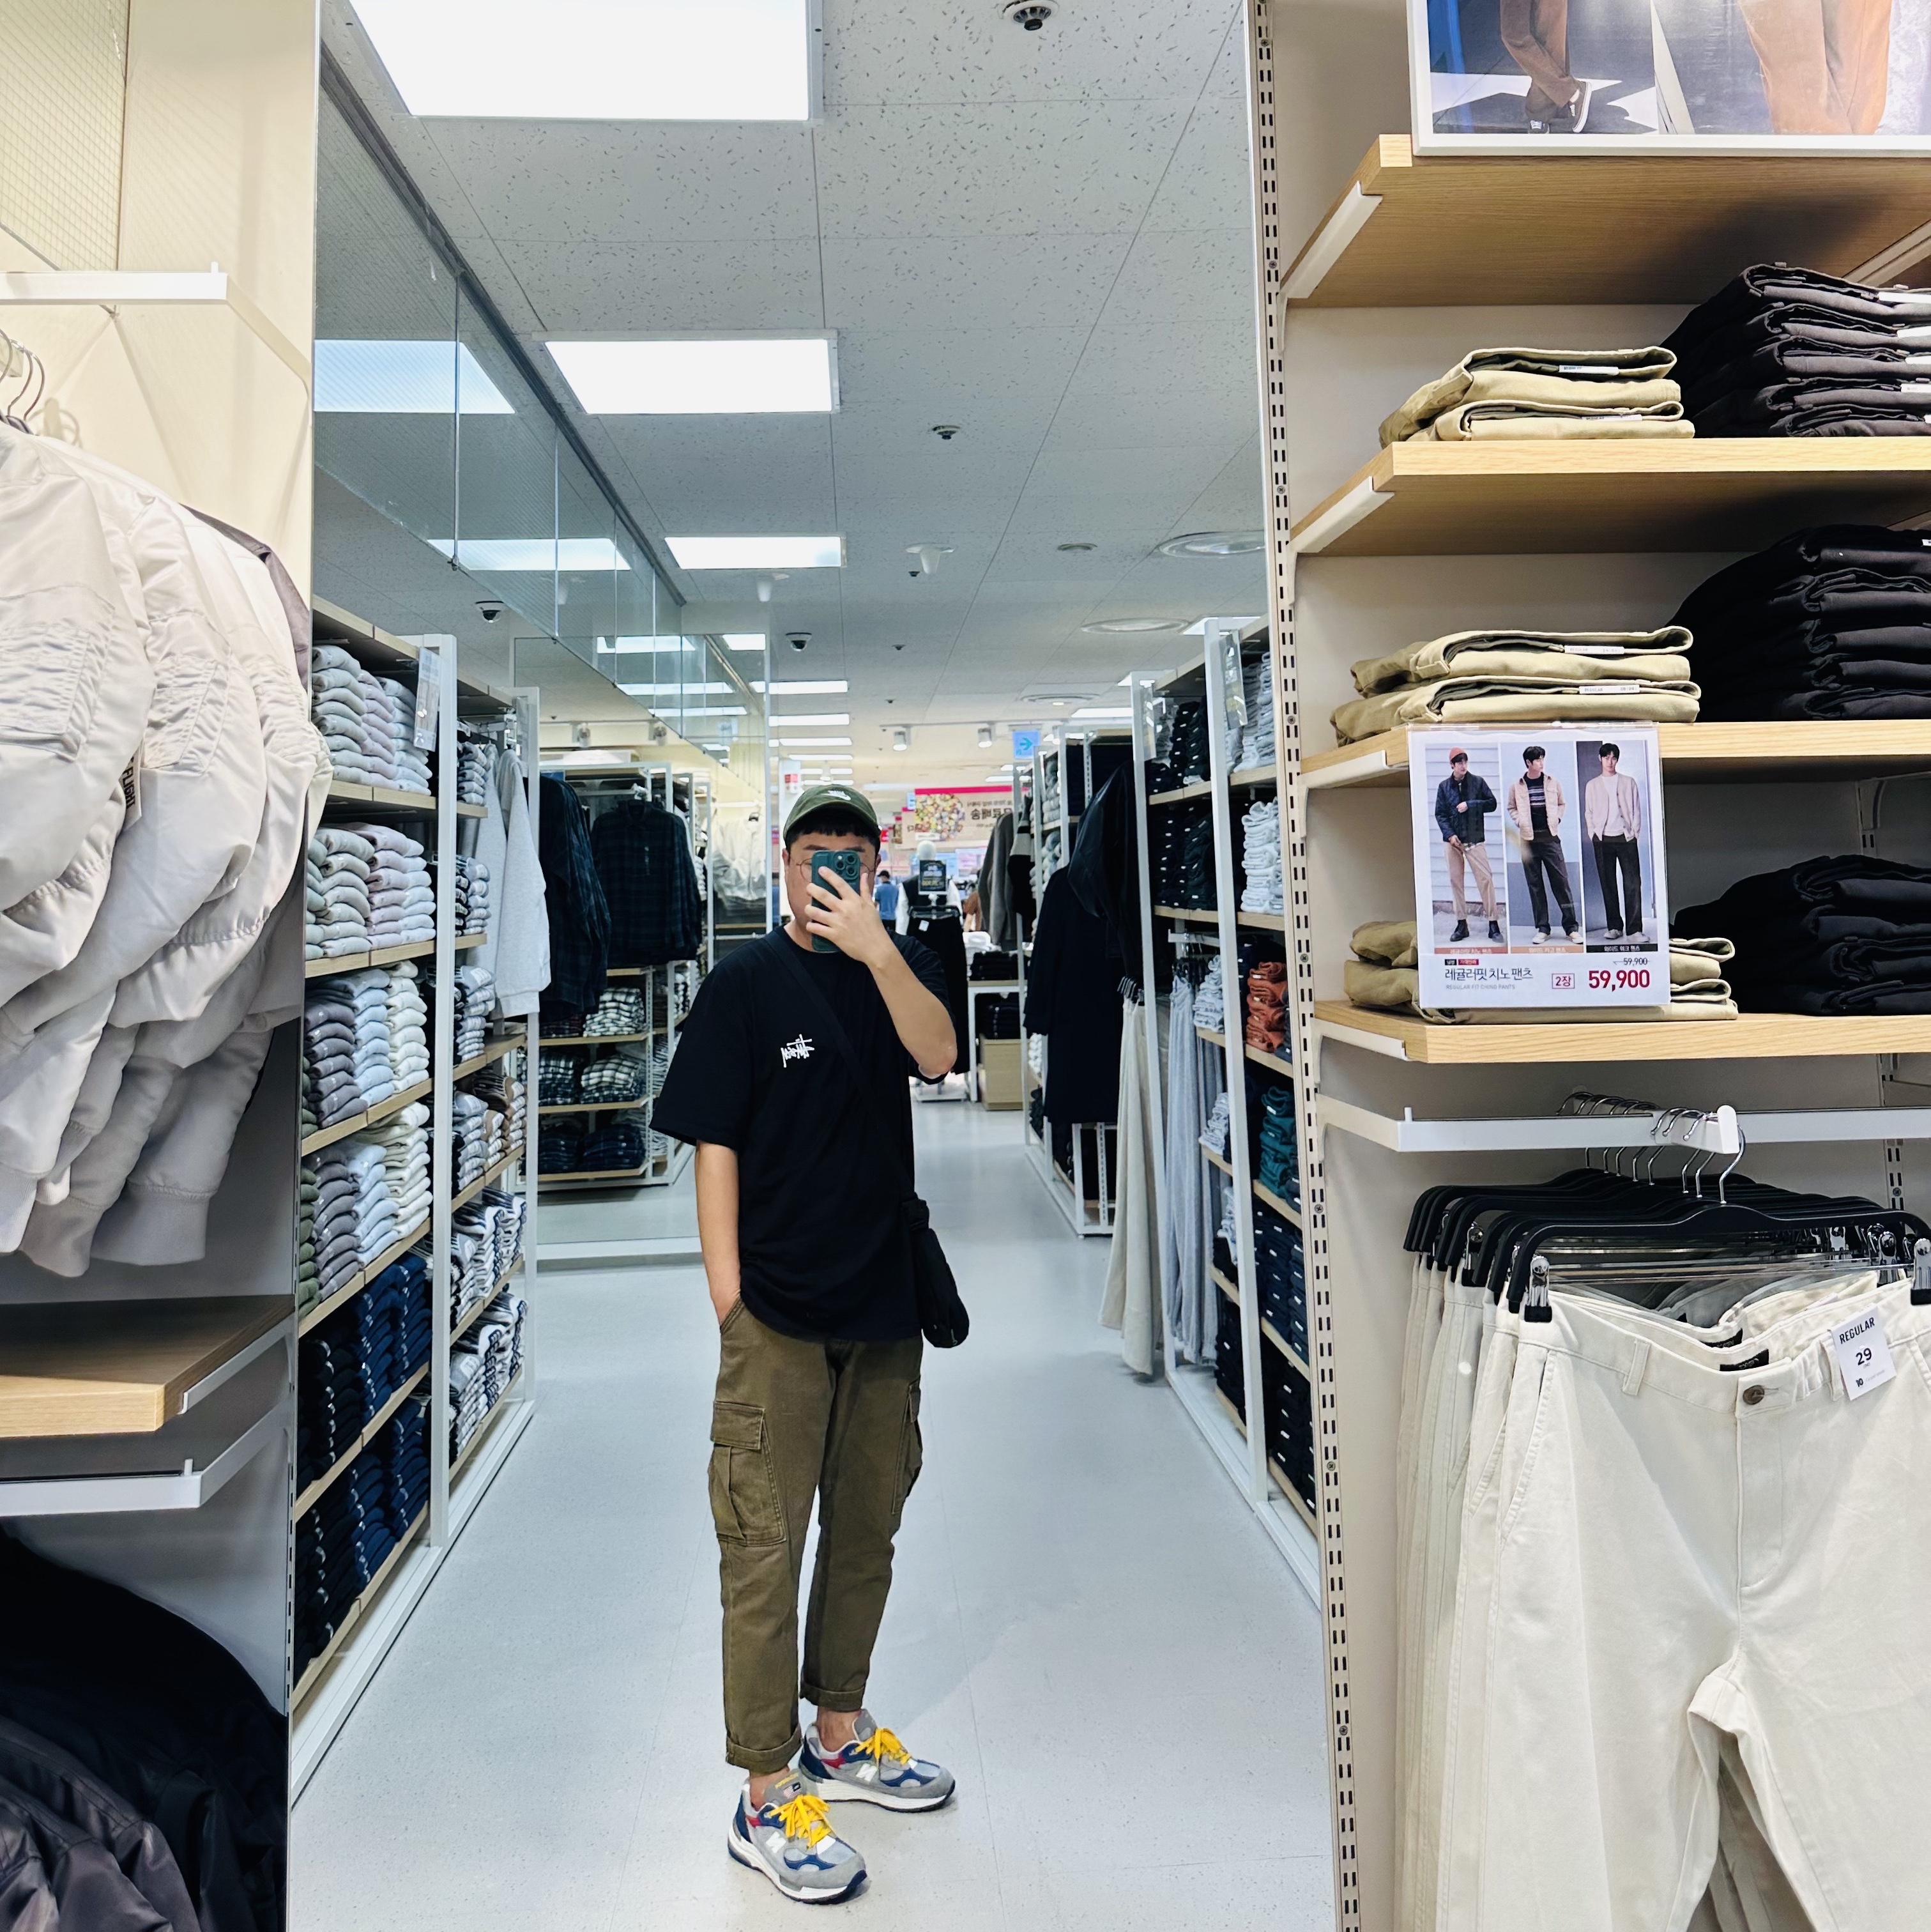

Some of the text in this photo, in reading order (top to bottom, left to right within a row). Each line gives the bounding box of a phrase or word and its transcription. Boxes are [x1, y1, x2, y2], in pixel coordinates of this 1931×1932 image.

[1623, 958, 1648, 966] 59,900
[1445, 967, 1534, 981] 레귤러핏 치노 팬츠
[1555, 976, 1571, 987] 2장
[1589, 969, 1650, 992] 59,900
[1839, 1317, 1875, 1344] REGULAR
[1856, 1347, 1872, 1365] 29
